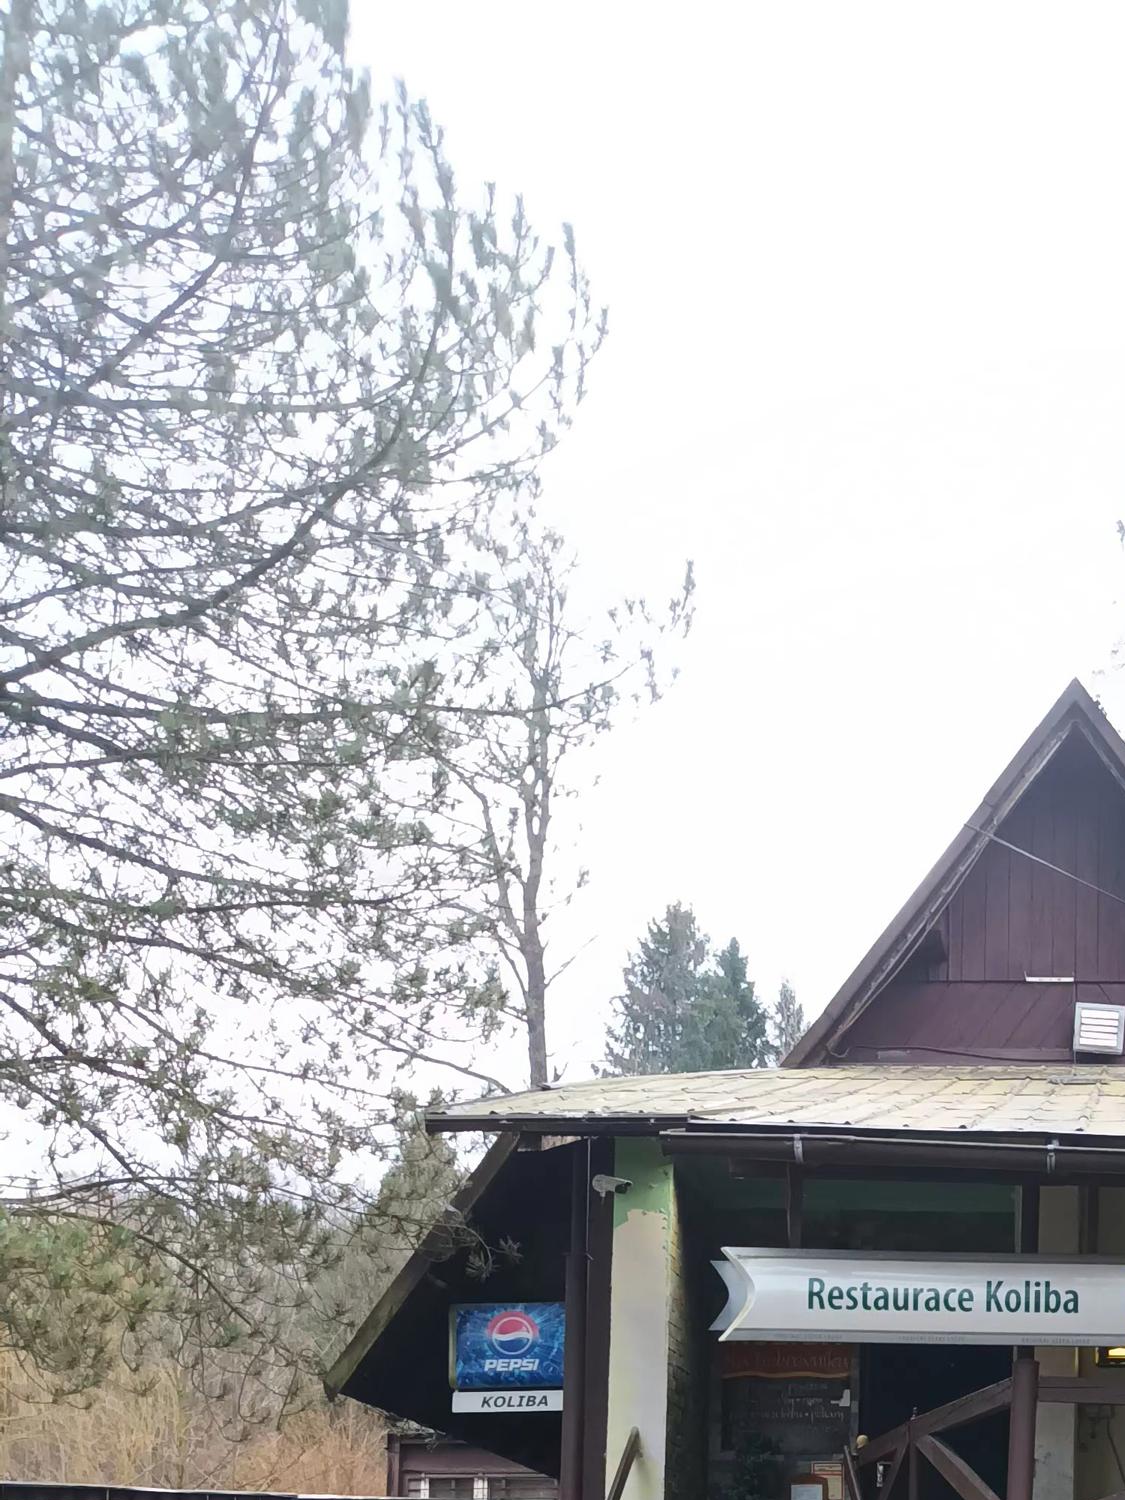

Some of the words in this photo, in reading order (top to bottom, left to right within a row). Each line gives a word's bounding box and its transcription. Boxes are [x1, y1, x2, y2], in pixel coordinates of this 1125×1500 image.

[807, 1277, 974, 1312] Restaurace
[986, 1280, 1080, 1314] Koliba
[484, 1359, 540, 1371] PEPSI
[481, 1395, 549, 1408] KOLIBA
